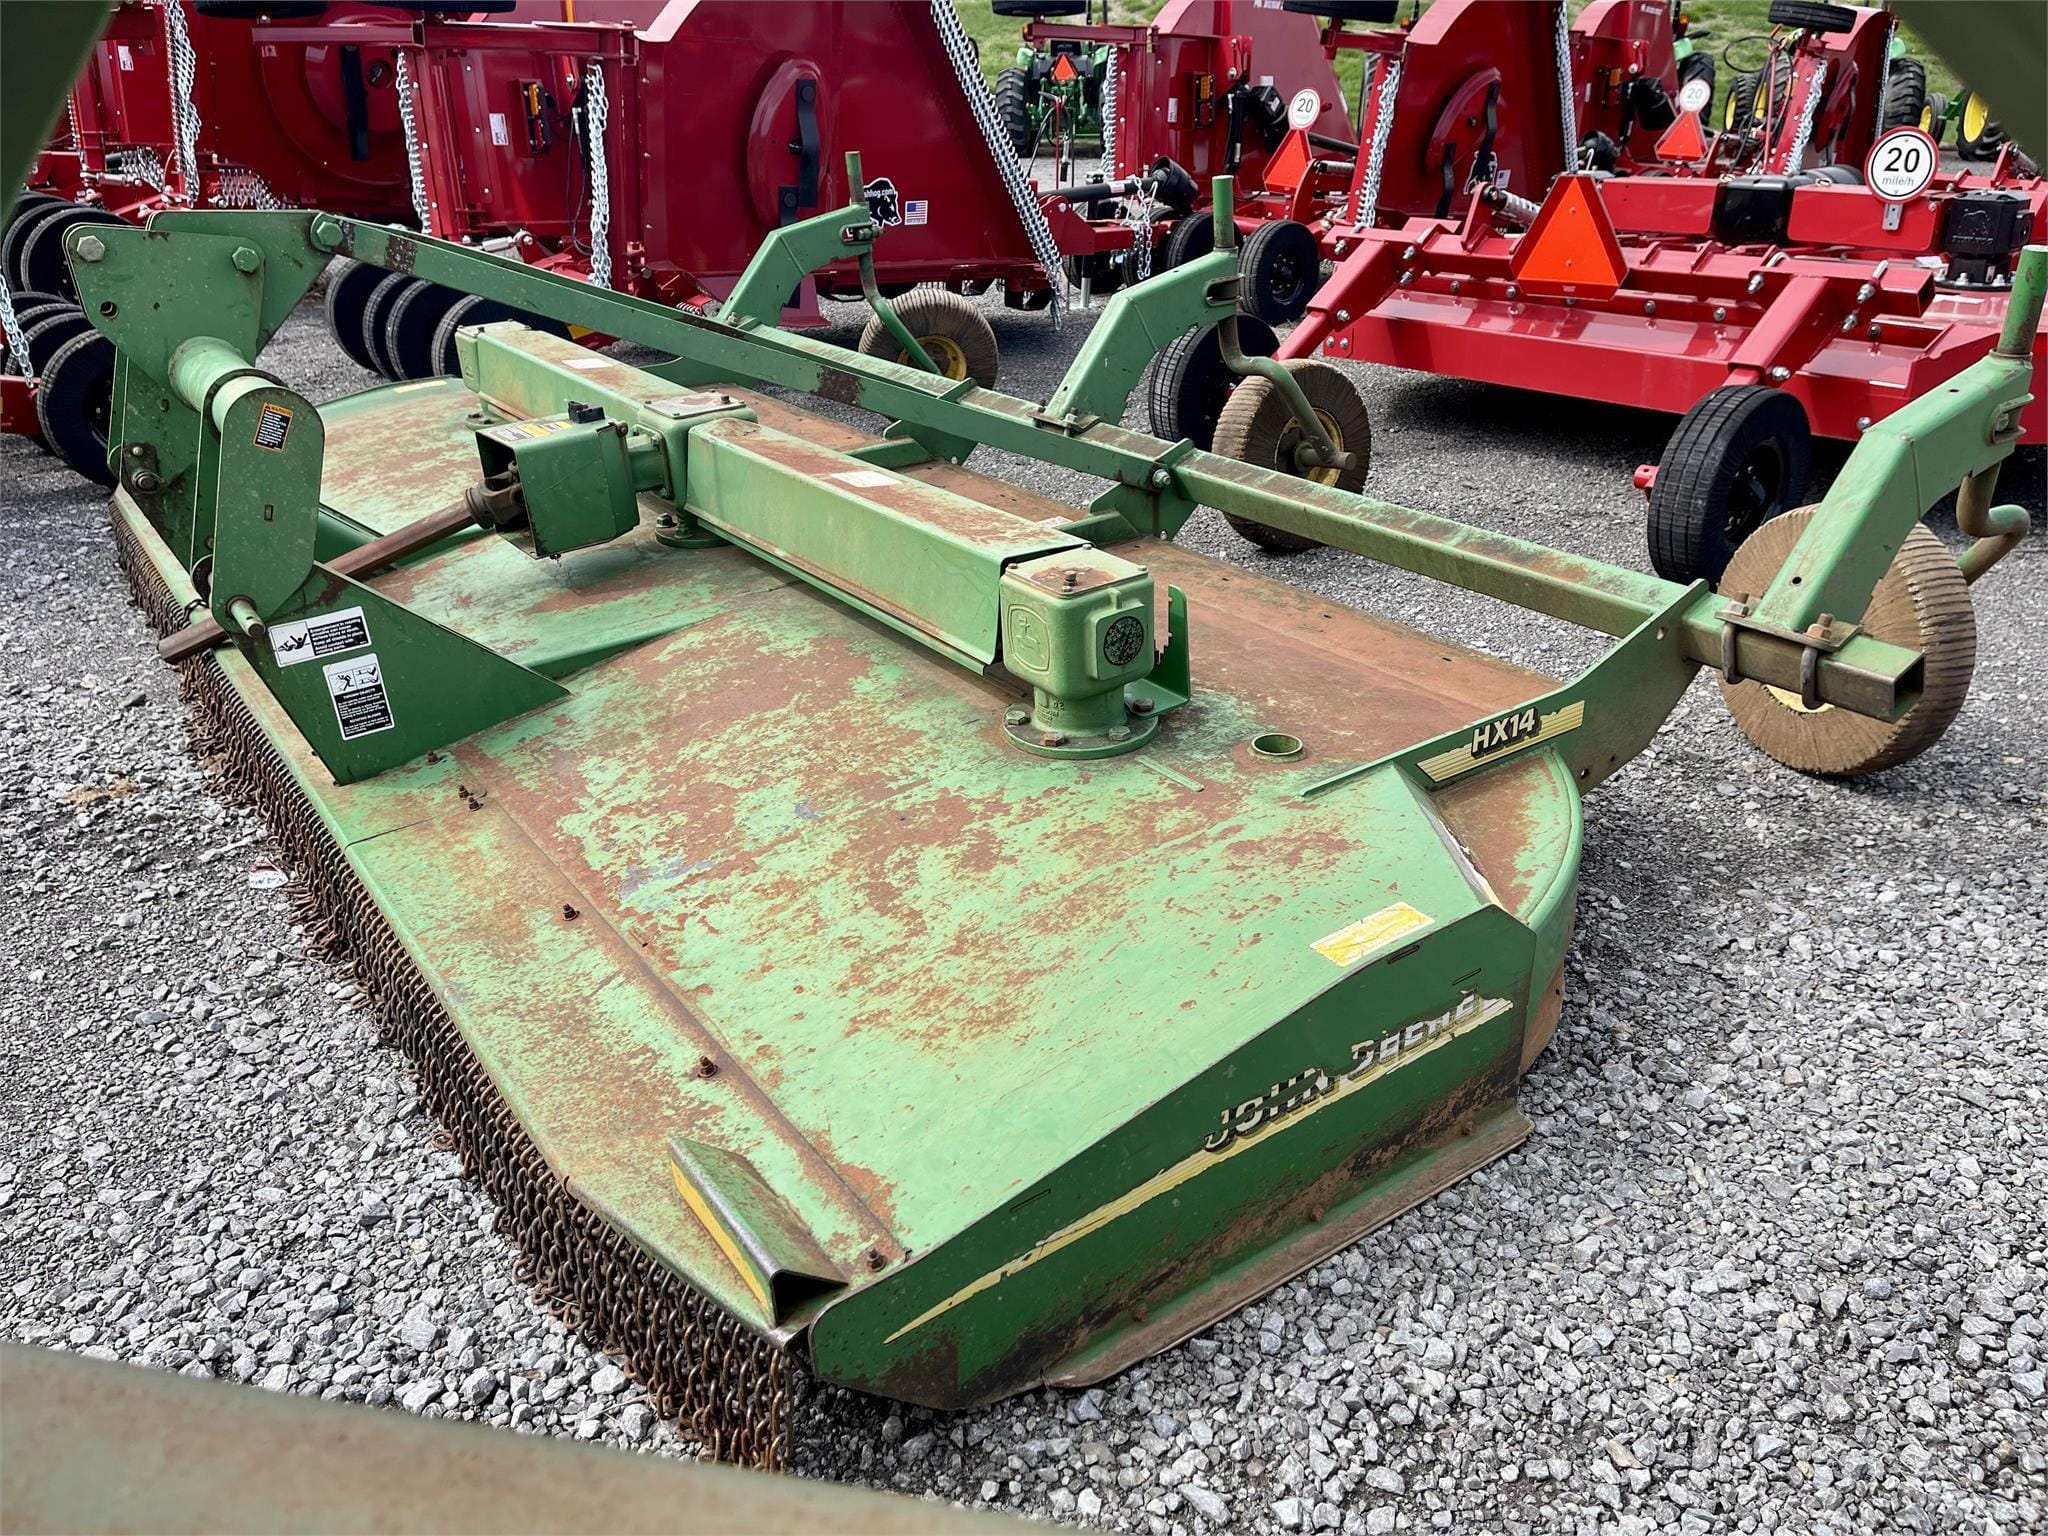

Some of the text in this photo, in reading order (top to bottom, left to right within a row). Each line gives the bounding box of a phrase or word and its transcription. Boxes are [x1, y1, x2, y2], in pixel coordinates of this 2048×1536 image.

[1296, 98, 1314, 113] 20
[1884, 147, 1920, 173] 20
[1881, 176, 1915, 186] mile/h
[864, 188, 894, 199] shhog.com
[1471, 707, 1538, 756] HX14
